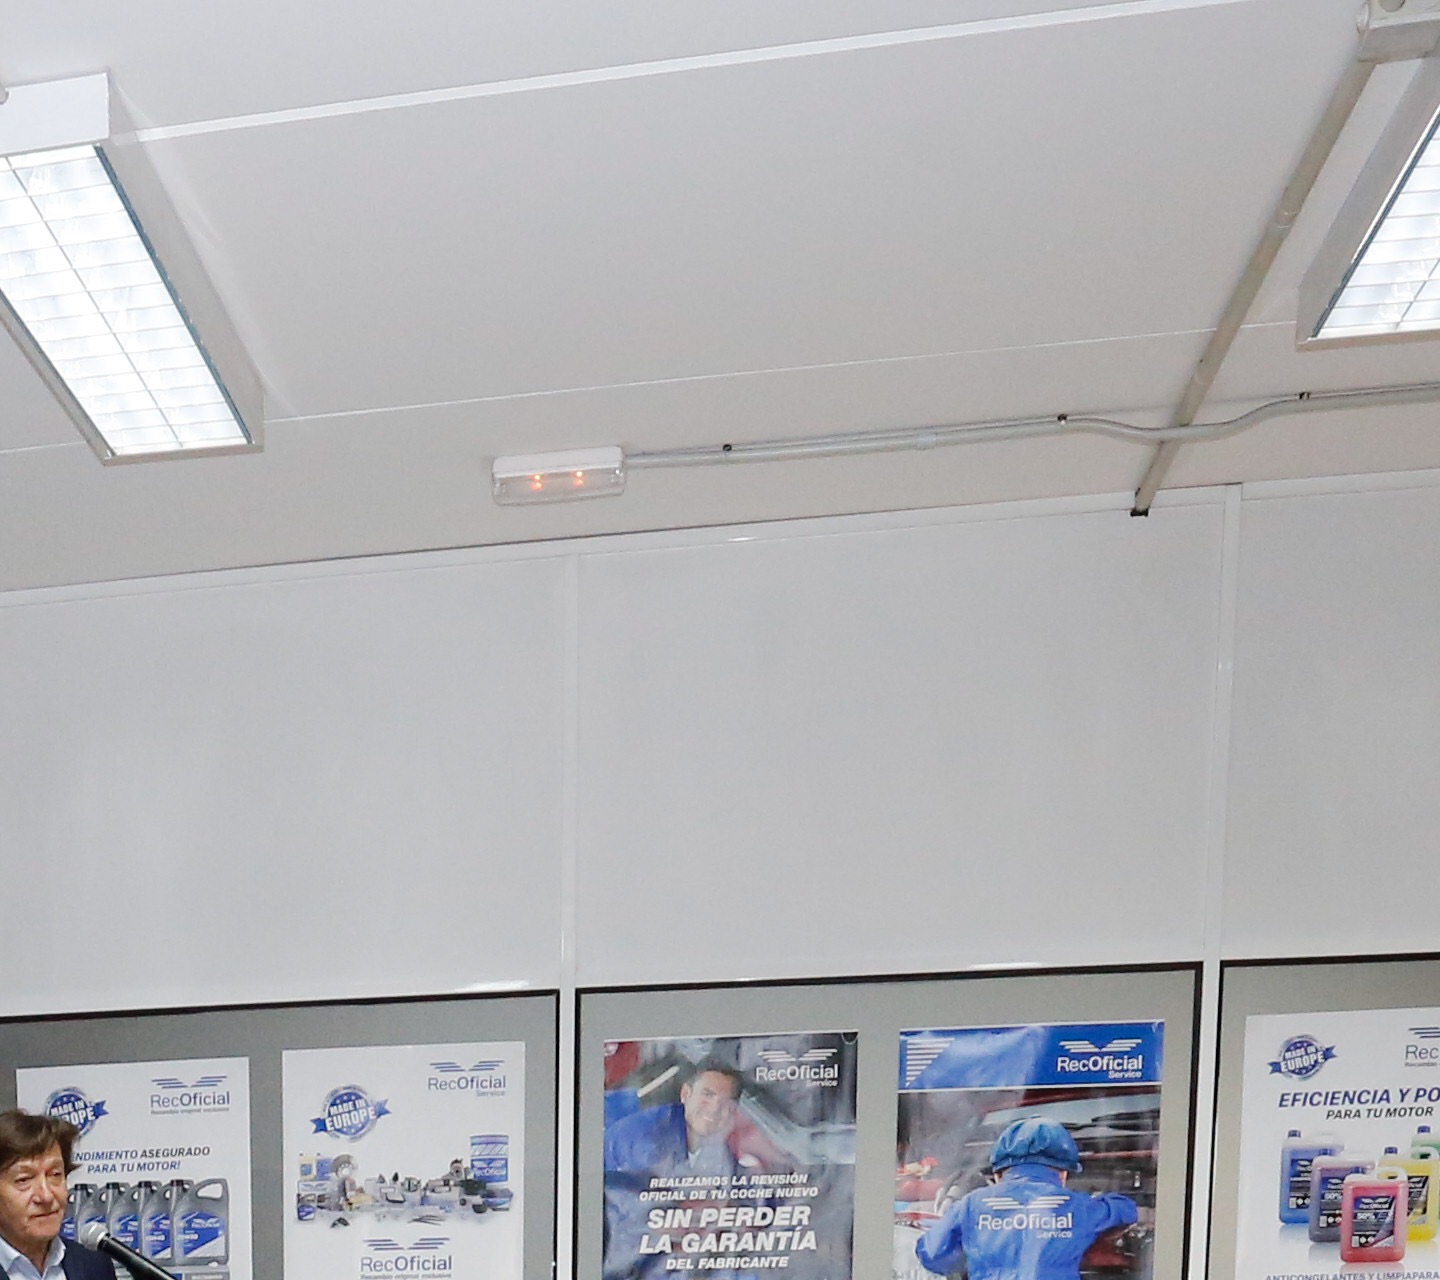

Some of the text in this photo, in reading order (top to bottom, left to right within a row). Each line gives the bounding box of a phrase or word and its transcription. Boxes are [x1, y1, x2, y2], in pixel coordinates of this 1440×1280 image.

[1057, 1055, 1142, 1072] RecOficial
[1280, 1051, 1325, 1073] EUROPE
[756, 1064, 838, 1082] RecOficial
[428, 1076, 506, 1090] RecOficial
[151, 1091, 230, 1108] RecOficial
[1278, 1089, 1391, 1108] EFICIENCIA
[1398, 1089, 1411, 1104] Y
[330, 1100, 355, 1115] MADE
[1325, 1106, 1434, 1120] PARA TU MOTOR
[325, 1106, 377, 1131] EUROPE
[140, 1147, 210, 1158] ASEGURADO
[88, 1161, 181, 1174] PARA TU MOTOR!
[650, 1172, 808, 1188] REALIZAMOS LA REVISIÓN
[639, 1187, 818, 1201] OFICIAL DE TU COCHE NUEVO
[647, 1205, 811, 1229] SIN PERDER
[978, 1213, 1073, 1232] RecOficial
[639, 1226, 818, 1254] LA GARANTÍA
[361, 1256, 452, 1272] RecOficial
[666, 1256, 789, 1270] DEL FABRICANTE
[1369, 1273, 1375, 1280] Y
